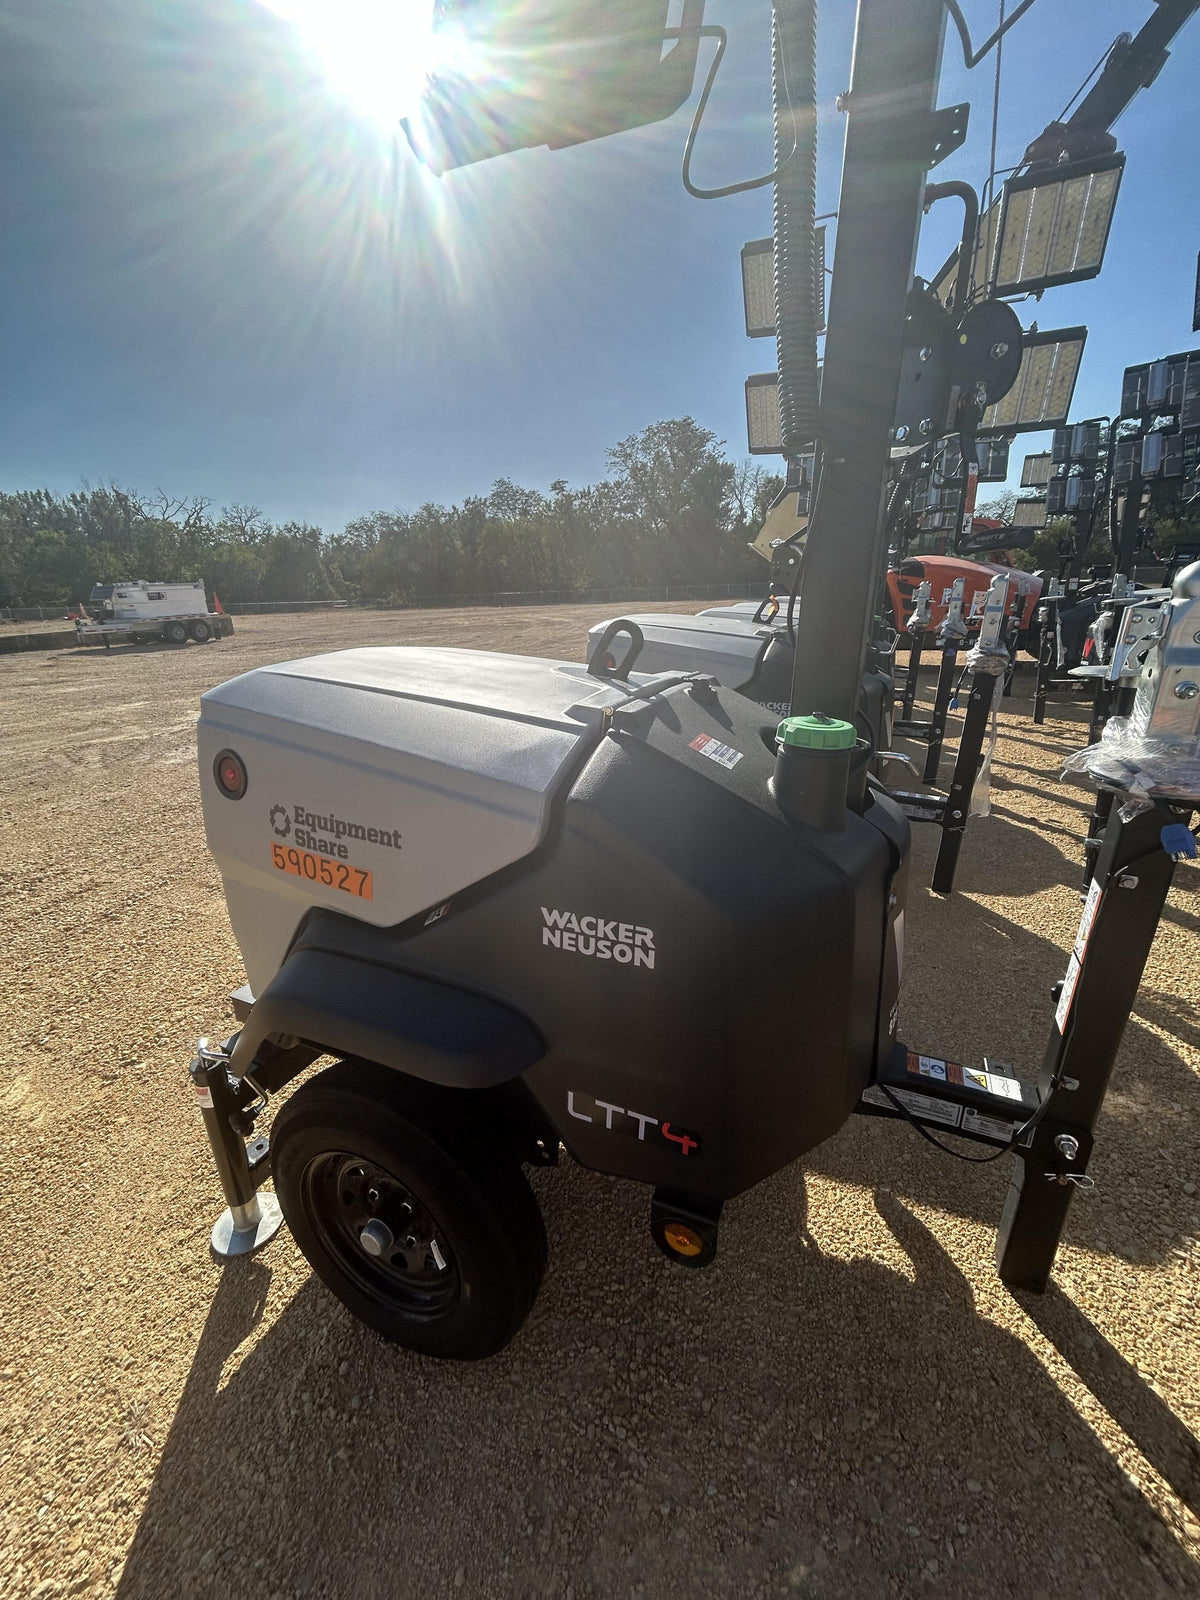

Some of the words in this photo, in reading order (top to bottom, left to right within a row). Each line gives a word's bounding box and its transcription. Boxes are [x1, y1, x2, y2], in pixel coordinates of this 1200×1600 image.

[757, 701, 792, 712] ACKE
[293, 805, 402, 850] Equipment
[294, 828, 349, 860] Share
[273, 843, 369, 897] 590527
[540, 906, 656, 949] WACKER
[542, 926, 656, 970] NEUSON
[567, 1090, 698, 1156] LTT4
